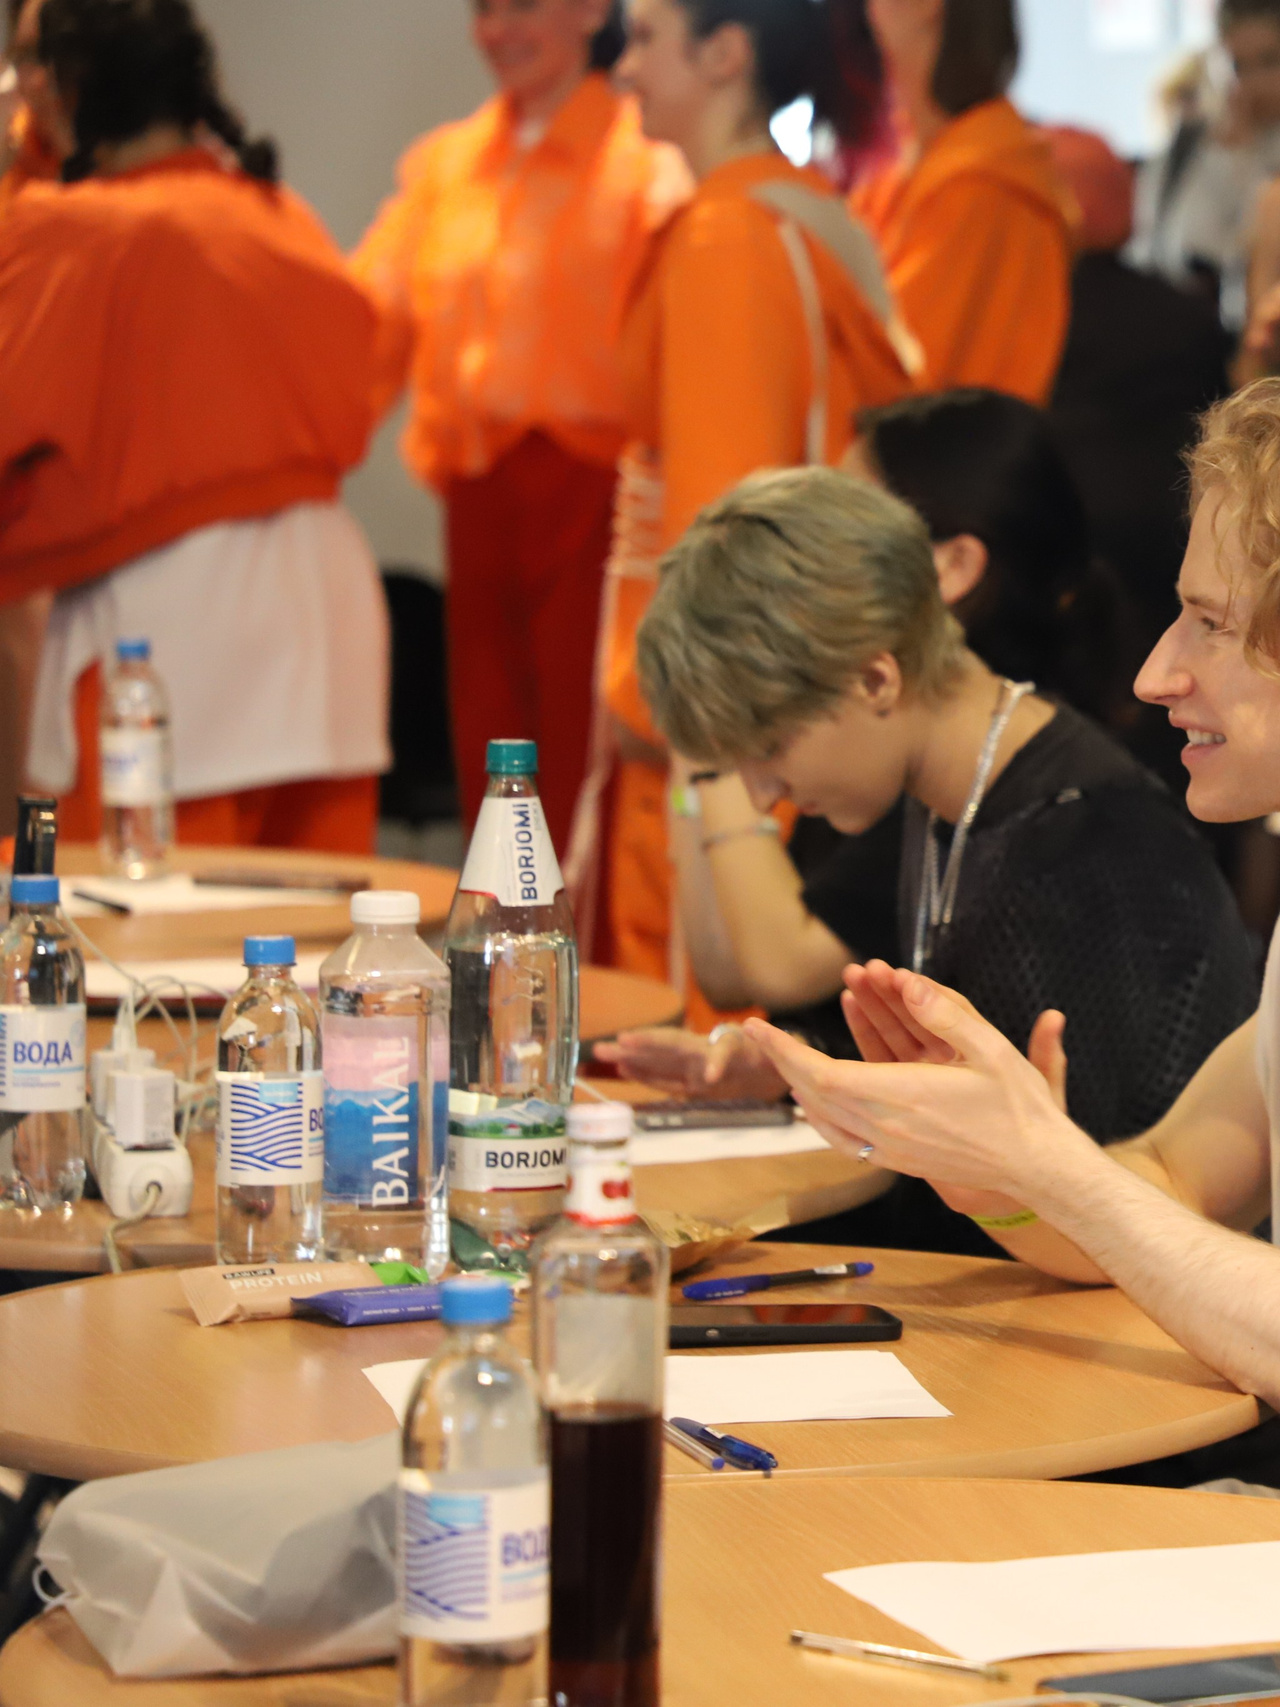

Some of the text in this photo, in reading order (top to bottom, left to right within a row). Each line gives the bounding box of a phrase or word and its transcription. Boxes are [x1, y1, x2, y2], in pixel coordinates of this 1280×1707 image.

[512, 803, 539, 901] BORJOMI
[13, 1041, 73, 1066] ВОДА
[371, 1036, 410, 1207] BAIKAL
[229, 1272, 323, 1291] PROTEIN
